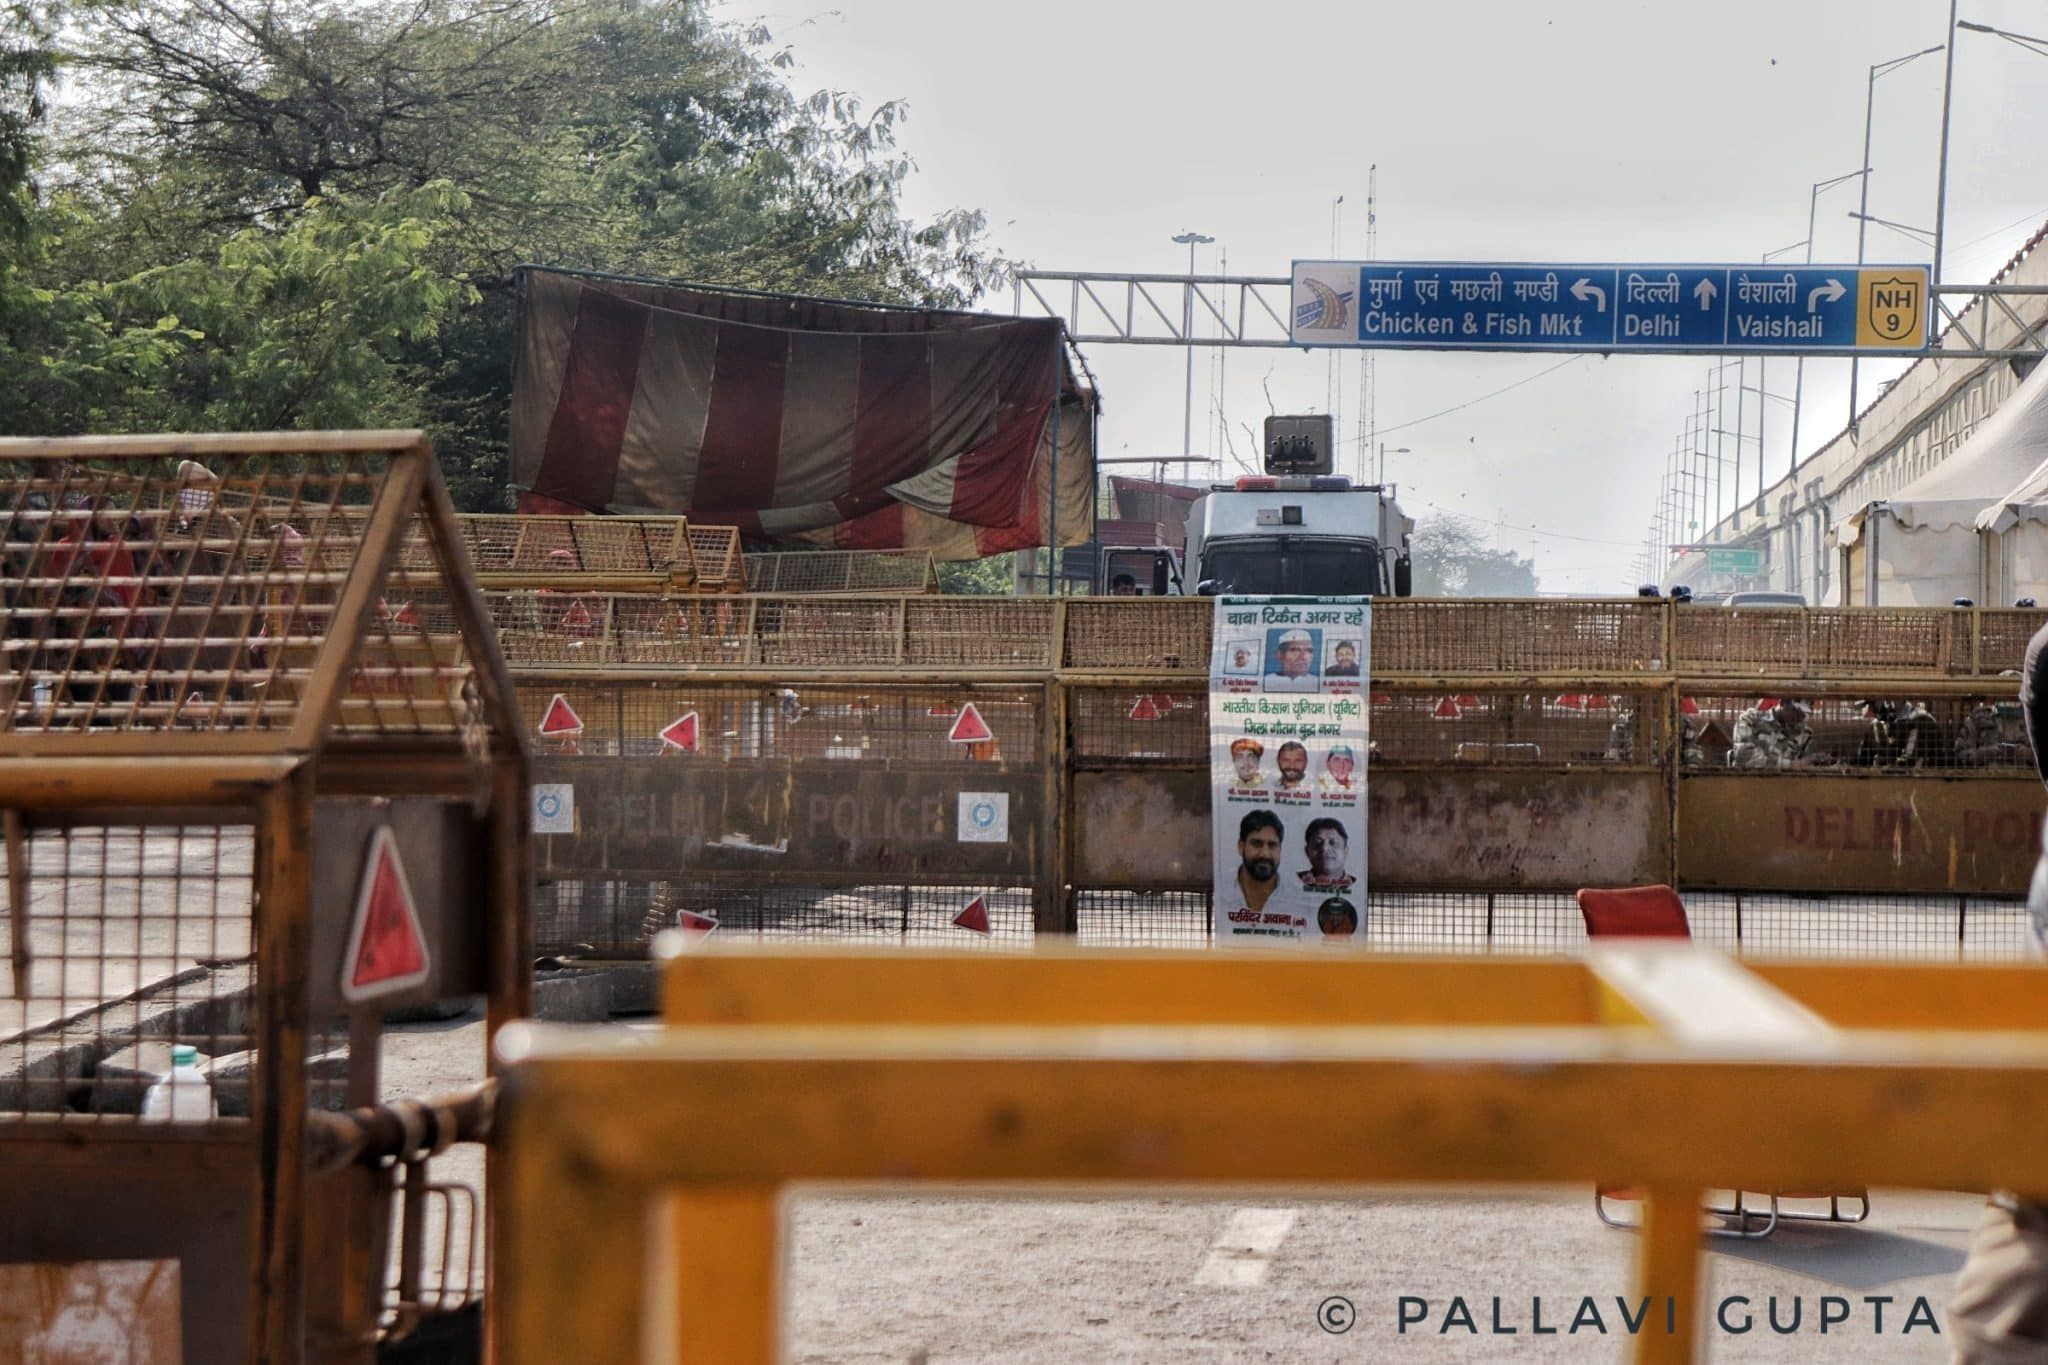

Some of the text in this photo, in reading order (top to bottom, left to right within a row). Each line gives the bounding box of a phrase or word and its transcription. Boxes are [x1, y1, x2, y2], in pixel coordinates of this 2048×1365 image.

[1369, 270, 1559, 309] मुर्गा एवं मछली मण्डी
[1626, 273, 1680, 304] दिल्ली
[1738, 273, 1797, 305] वैशाली
[1876, 290, 1911, 308] NH
[1365, 311, 1583, 336] Chicken & Fish Mkt
[1624, 314, 1680, 337] Delhi
[1737, 314, 1823, 337] Vaishali
[1887, 314, 1900, 332] 9
[1305, 611, 1341, 624] अमर
[1344, 608, 1363, 625] रहे
[1223, 698, 1256, 713] भारतीय
[1258, 698, 1289, 714] किसान
[1270, 719, 1296, 734] गौतम
[1318, 723, 1341, 735] नगर
[808, 793, 943, 840] POLICE
